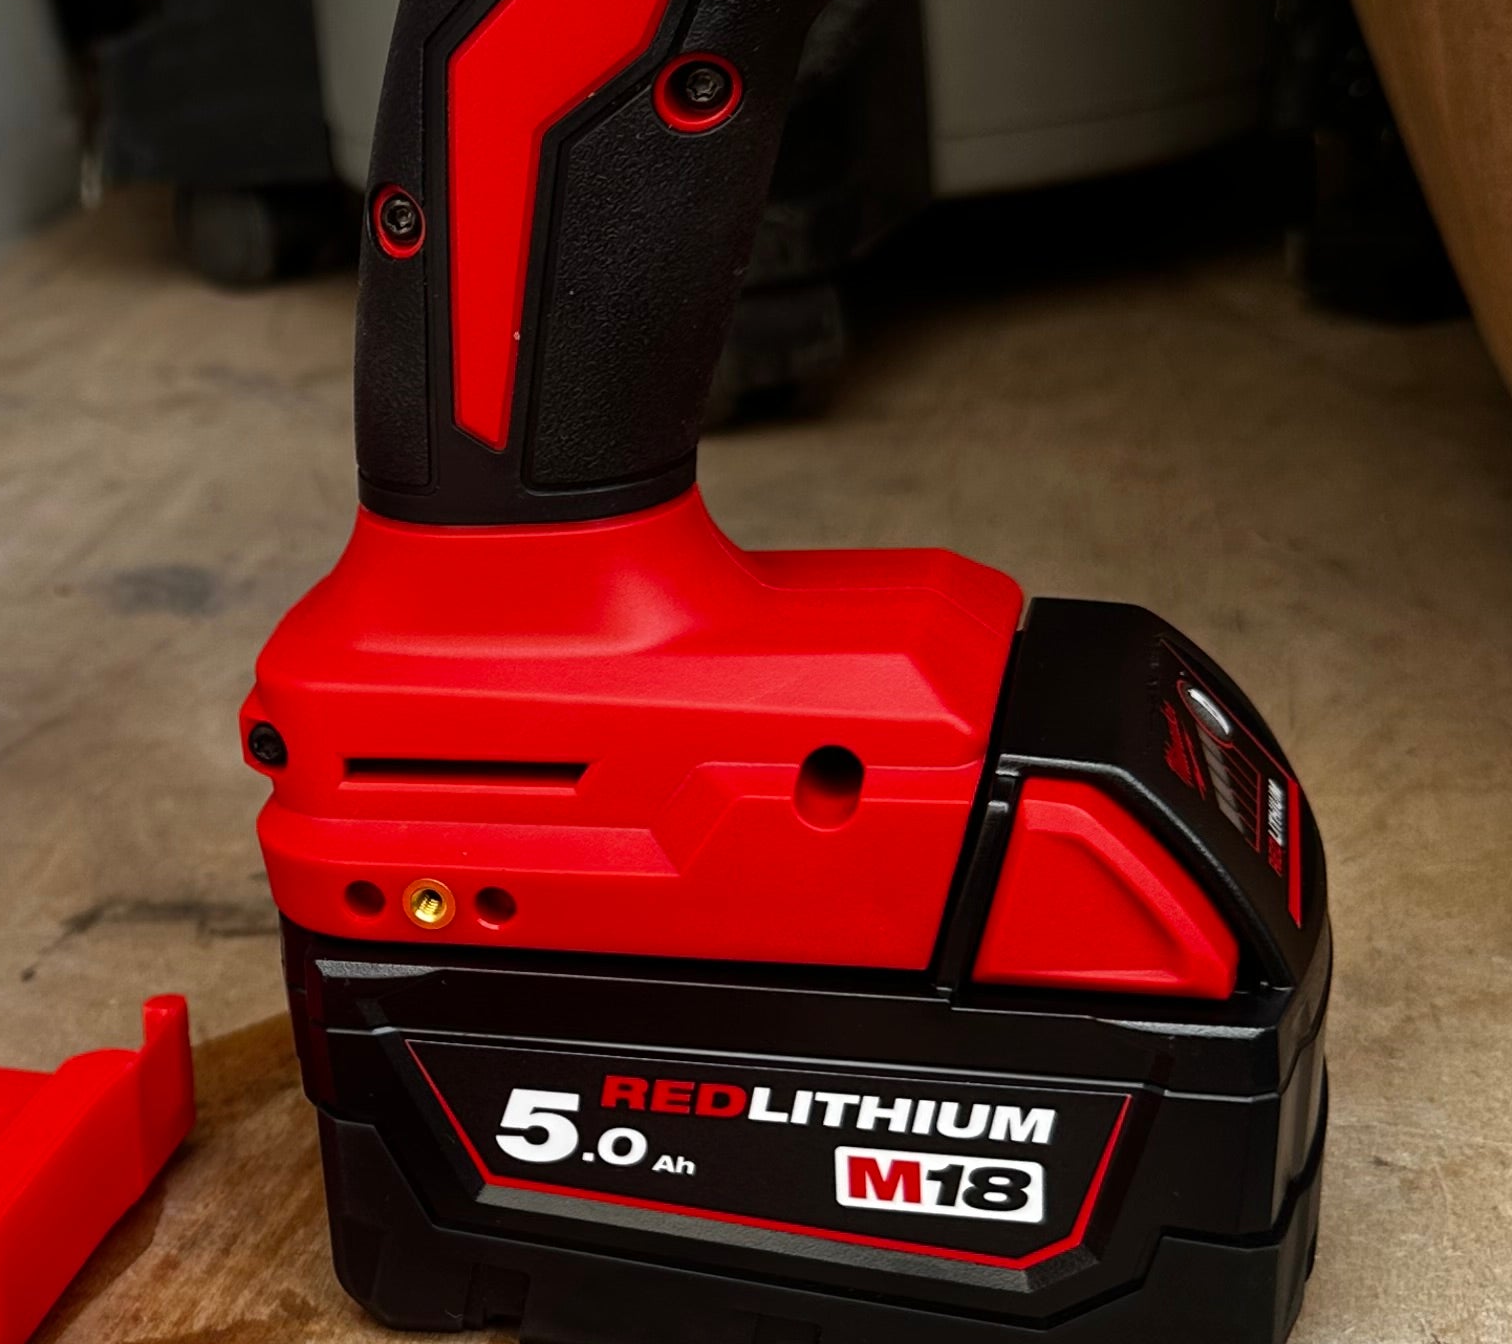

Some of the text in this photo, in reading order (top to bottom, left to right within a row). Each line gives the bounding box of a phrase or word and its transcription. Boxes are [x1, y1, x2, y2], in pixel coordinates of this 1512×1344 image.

[495, 1088, 696, 1176] 5.0 Ah
[600, 1074, 1057, 1146] REDLITHIUM
[847, 1156, 1032, 1212] M18
